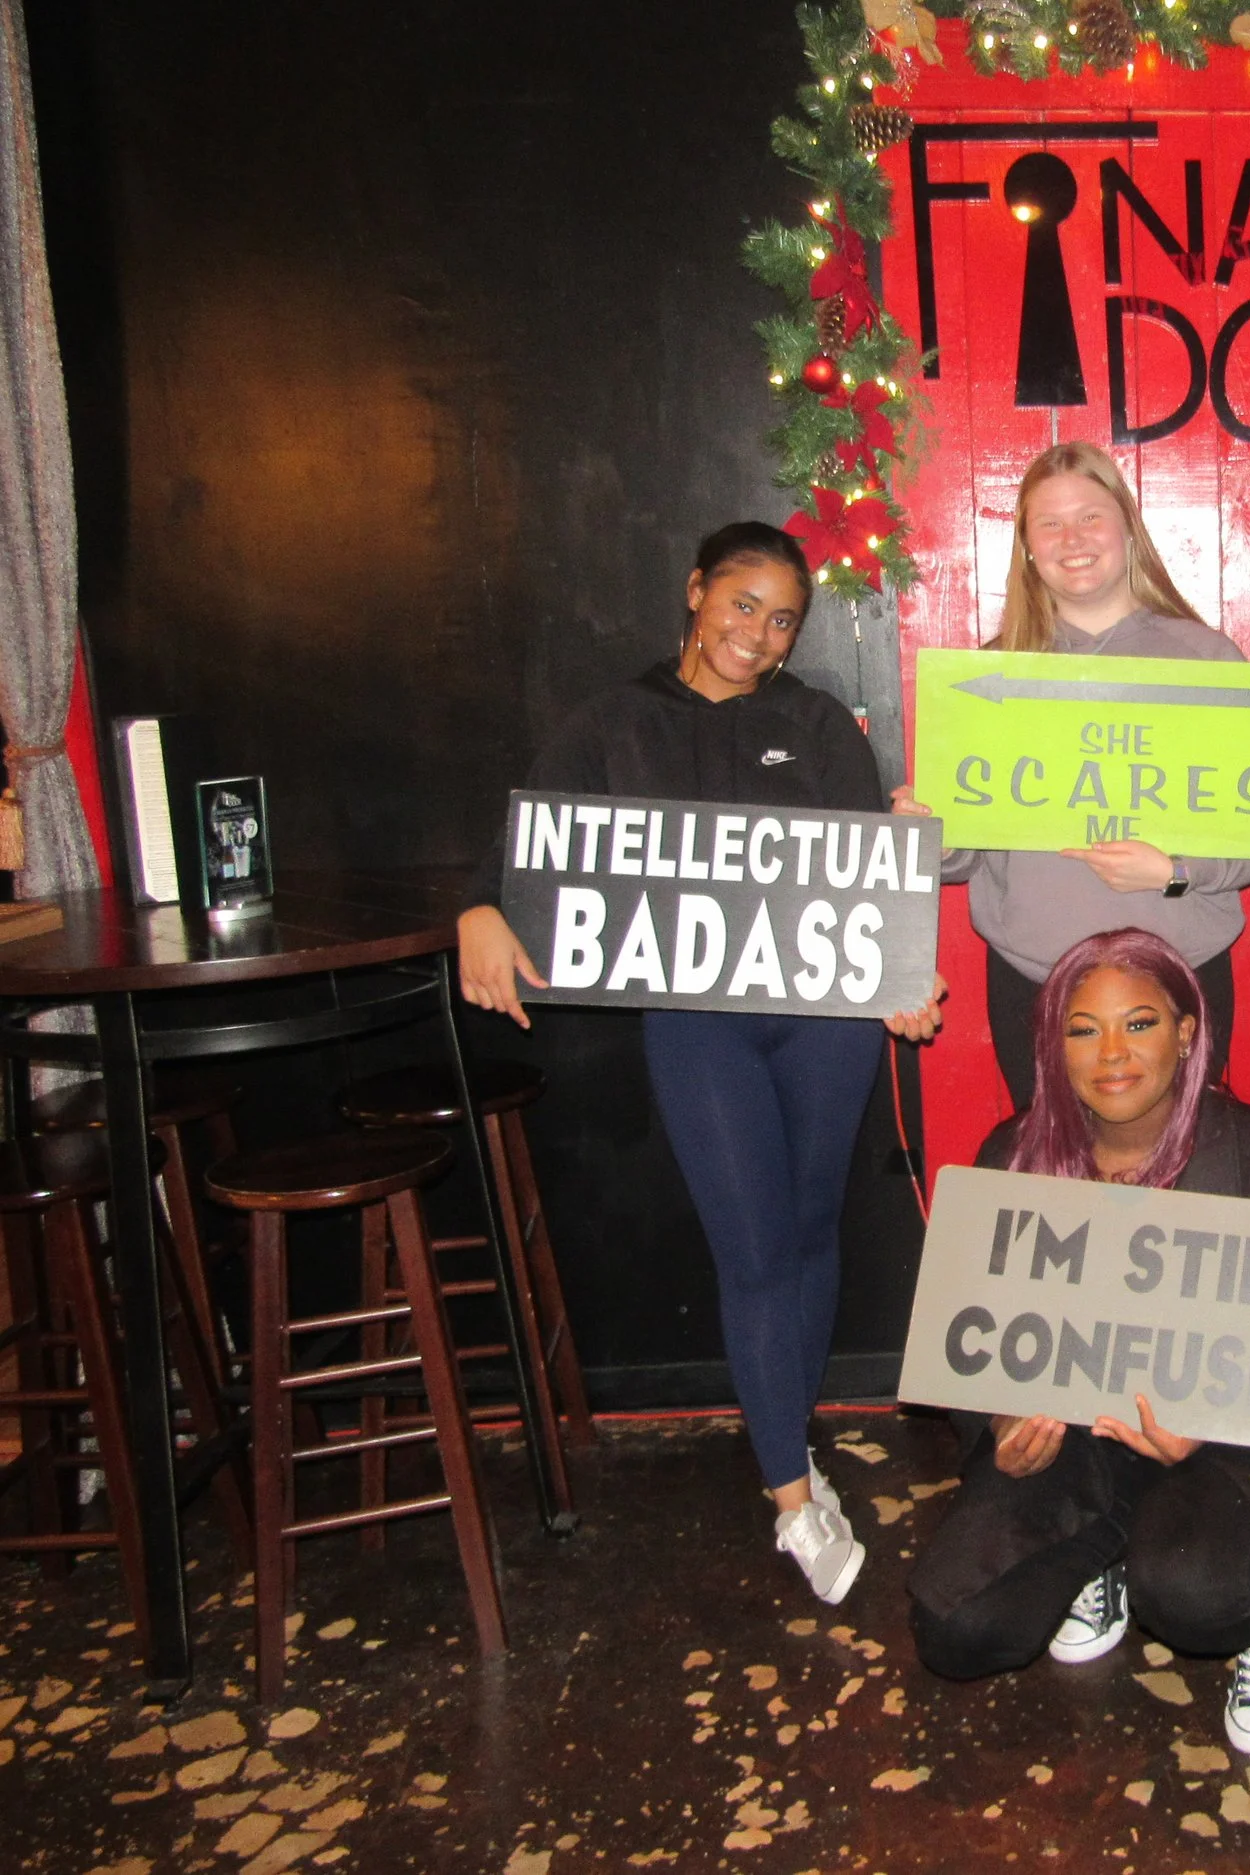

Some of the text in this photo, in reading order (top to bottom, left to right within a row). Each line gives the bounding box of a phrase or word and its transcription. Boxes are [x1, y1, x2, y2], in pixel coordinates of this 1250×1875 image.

[1079, 722, 1153, 756] SHE
[513, 801, 935, 894] INTELLECTUAL
[1086, 815, 1142, 845] ME
[550, 886, 885, 1004] BADASS
[988, 1208, 1091, 1286] I'M
